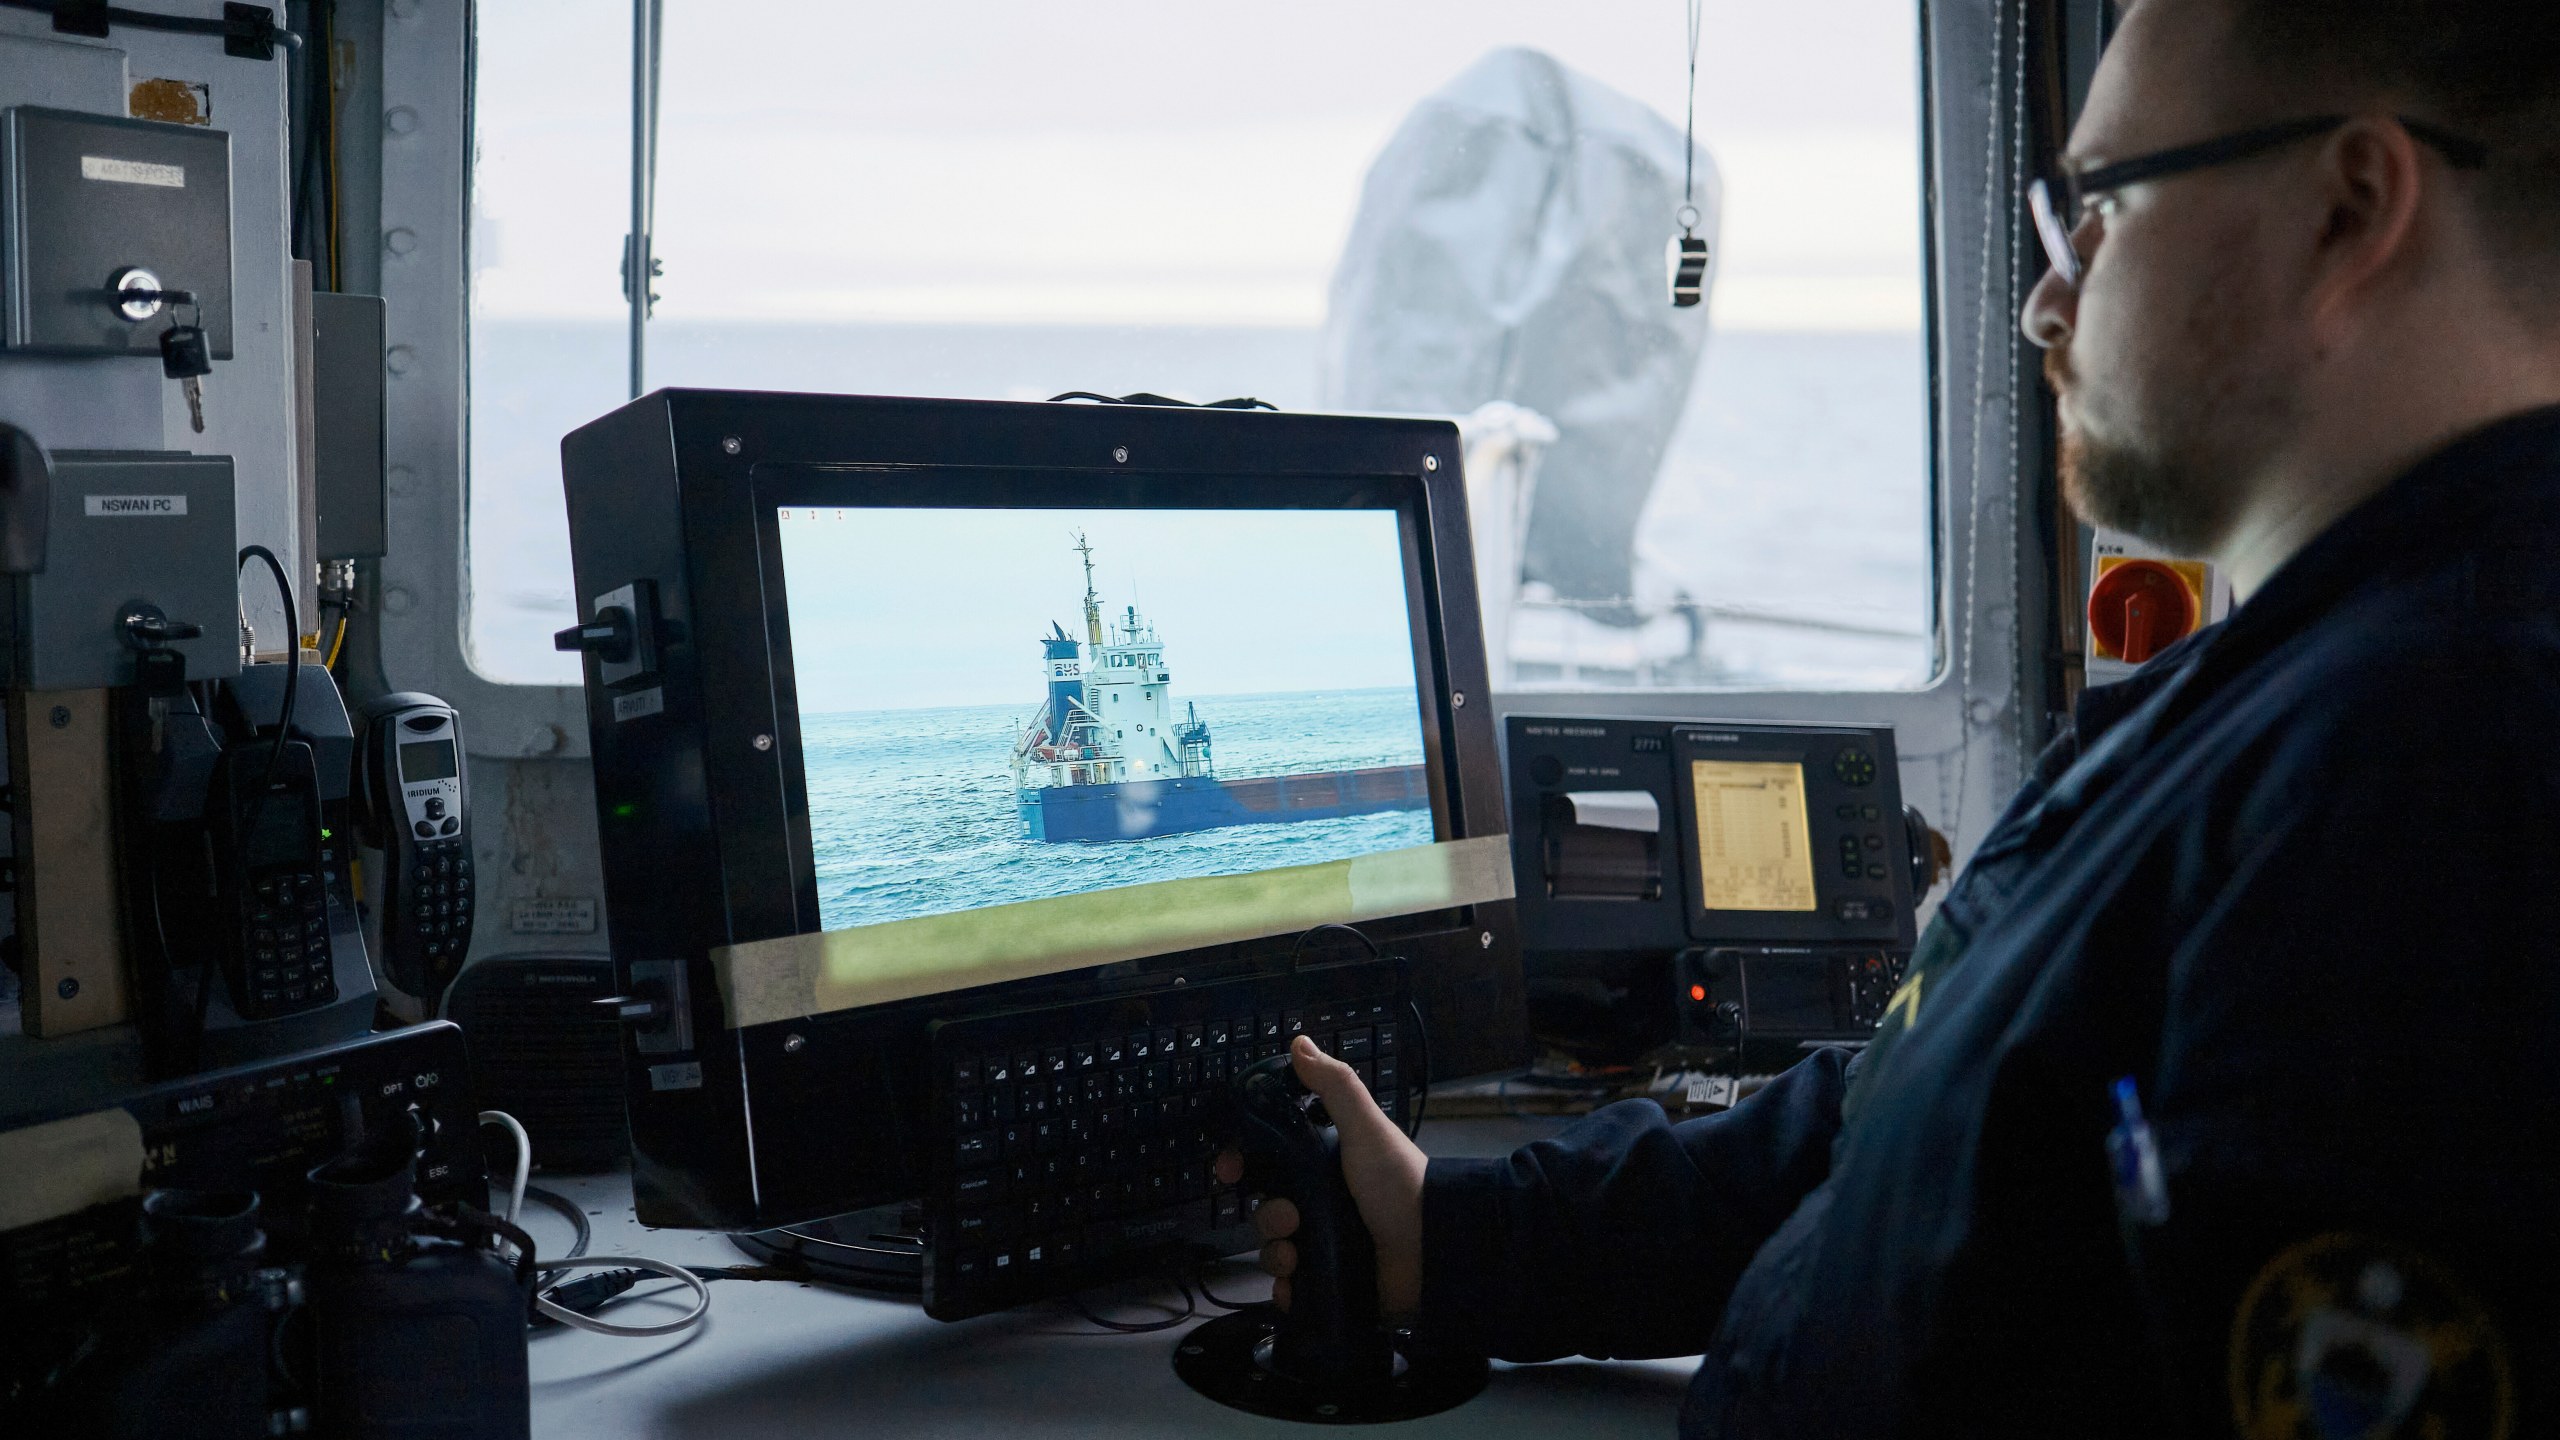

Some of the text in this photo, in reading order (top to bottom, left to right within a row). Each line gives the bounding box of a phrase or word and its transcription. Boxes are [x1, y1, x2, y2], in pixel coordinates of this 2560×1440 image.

[102, 499, 171, 511] NSWAN PC
[407, 787, 440, 799] IRIDIUM
[384, 1082, 403, 1096] OPT
[1191, 1097, 1197, 1107] U
[1162, 1103, 1168, 1112] Y
[1133, 1108, 1139, 1118] T
[1102, 1114, 1108, 1123] R
[1071, 1119, 1077, 1130] E
[1040, 1125, 1049, 1135] W
[1008, 1131, 1015, 1141] Q
[1198, 1132, 1204, 1142] J
[1140, 1144, 1146, 1154] G
[1169, 1139, 1175, 1149] H
[1110, 1150, 1116, 1159] F
[1079, 1156, 1086, 1165] D
[430, 1164, 449, 1179] ESC
[1049, 1162, 1055, 1172] S
[1017, 1168, 1024, 1179] A
[1183, 1172, 1189, 1180] N
[1154, 1177, 1160, 1187] B
[1126, 1184, 1131, 1192] V
[1095, 1190, 1100, 1199] C
[1064, 1197, 1070, 1206] X
[1033, 1202, 1039, 1212] Z
